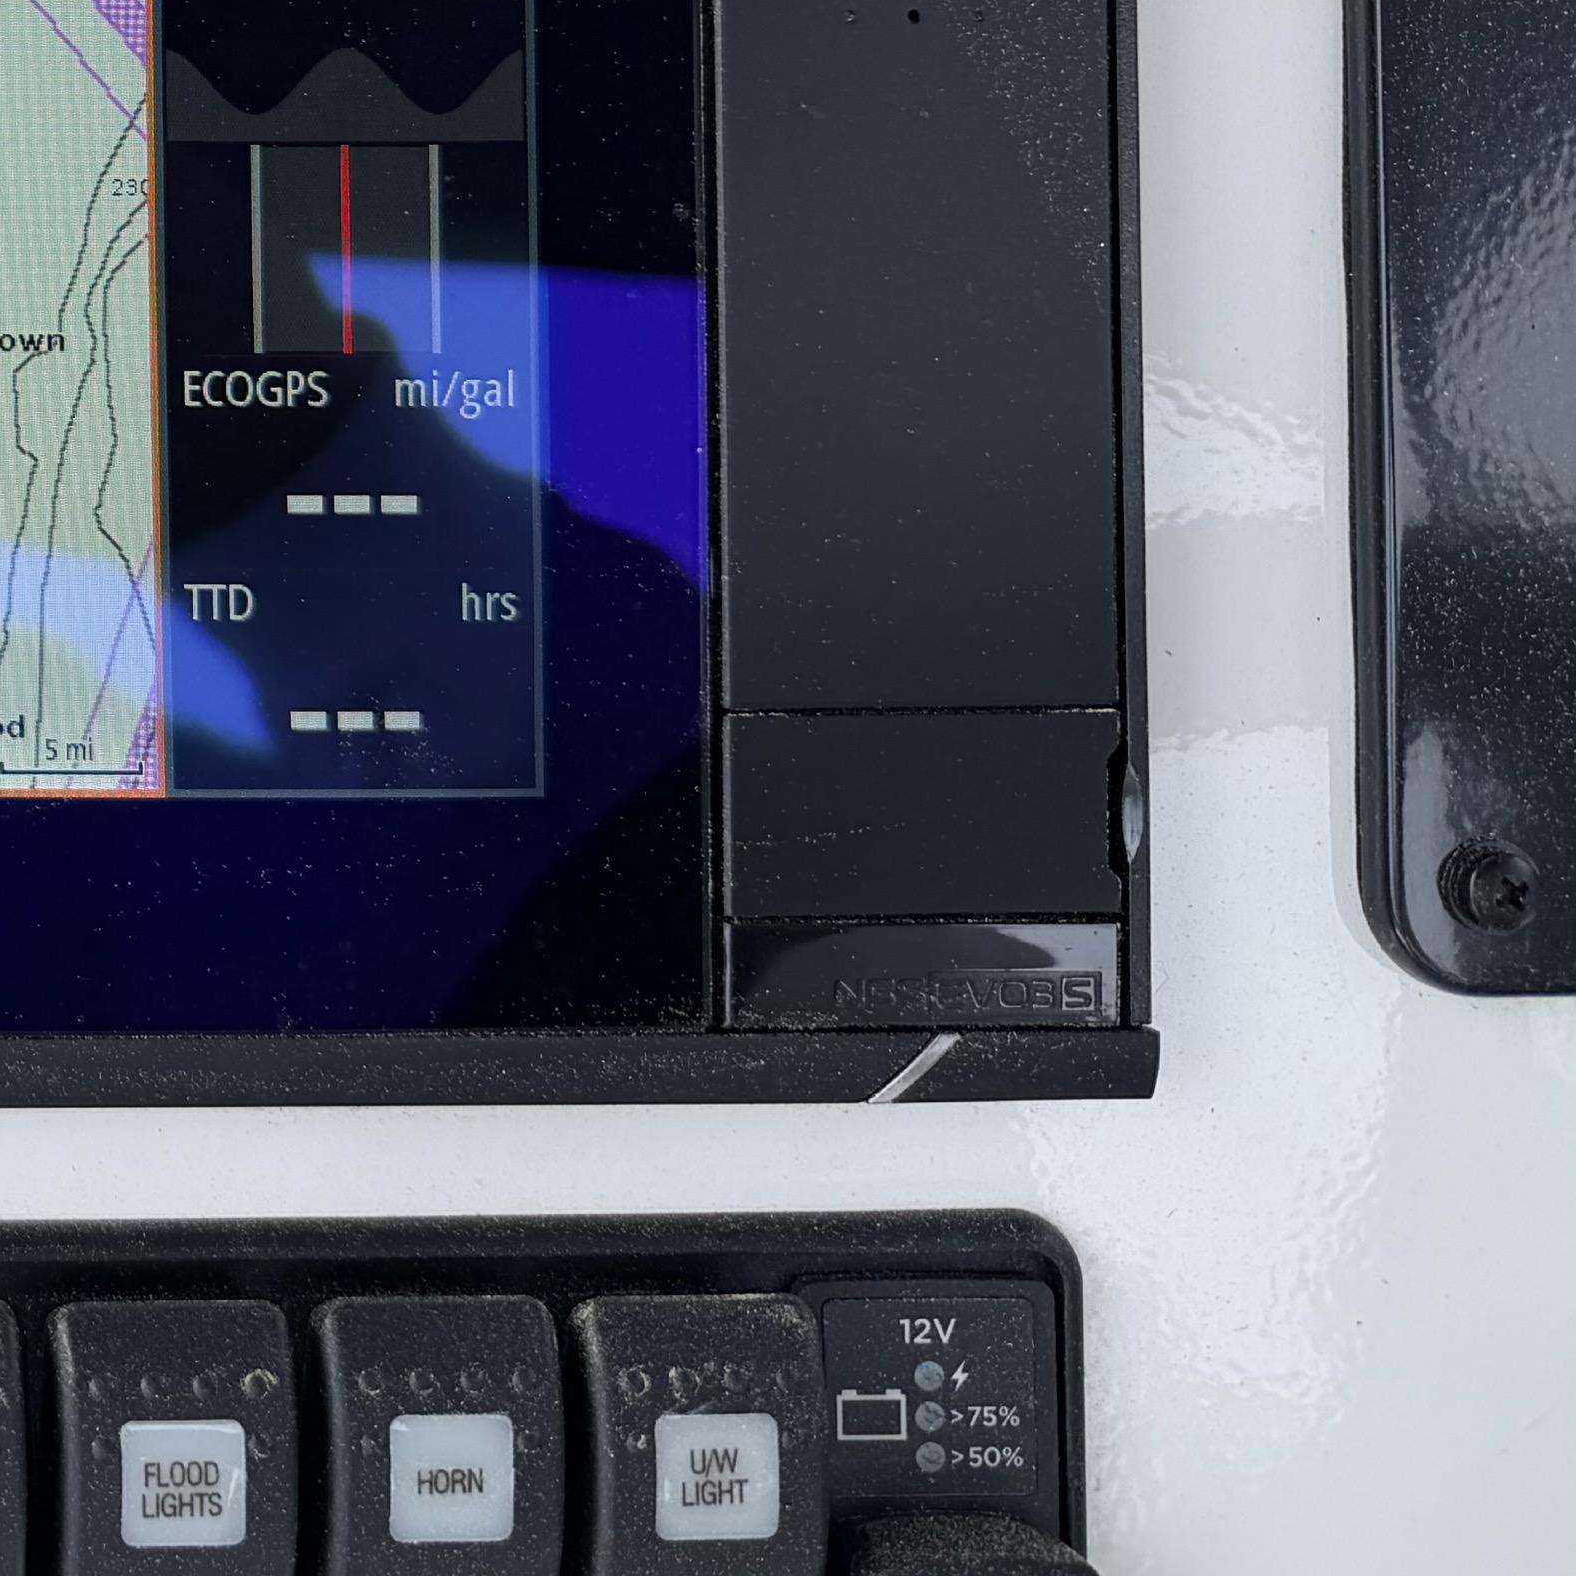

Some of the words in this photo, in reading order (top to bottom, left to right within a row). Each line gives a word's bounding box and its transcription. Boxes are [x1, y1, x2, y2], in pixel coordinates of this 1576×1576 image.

[183, 369, 332, 408] ECOGPS
[394, 368, 516, 419] mi/gal
[183, 582, 257, 622] TTD
[460, 581, 520, 622] hrs
[45, 739, 58, 761] 5
[65, 738, 95, 761] mi
[899, 1317, 956, 1345] 12V
[950, 1405, 1021, 1429] >75%
[689, 1447, 740, 1476] U/W
[950, 1445, 1025, 1469] >50%
[143, 1461, 220, 1488] FLOOD
[417, 1468, 485, 1496] HORN
[141, 1492, 223, 1519] LIGHTS
[681, 1478, 750, 1507] LIGHT
